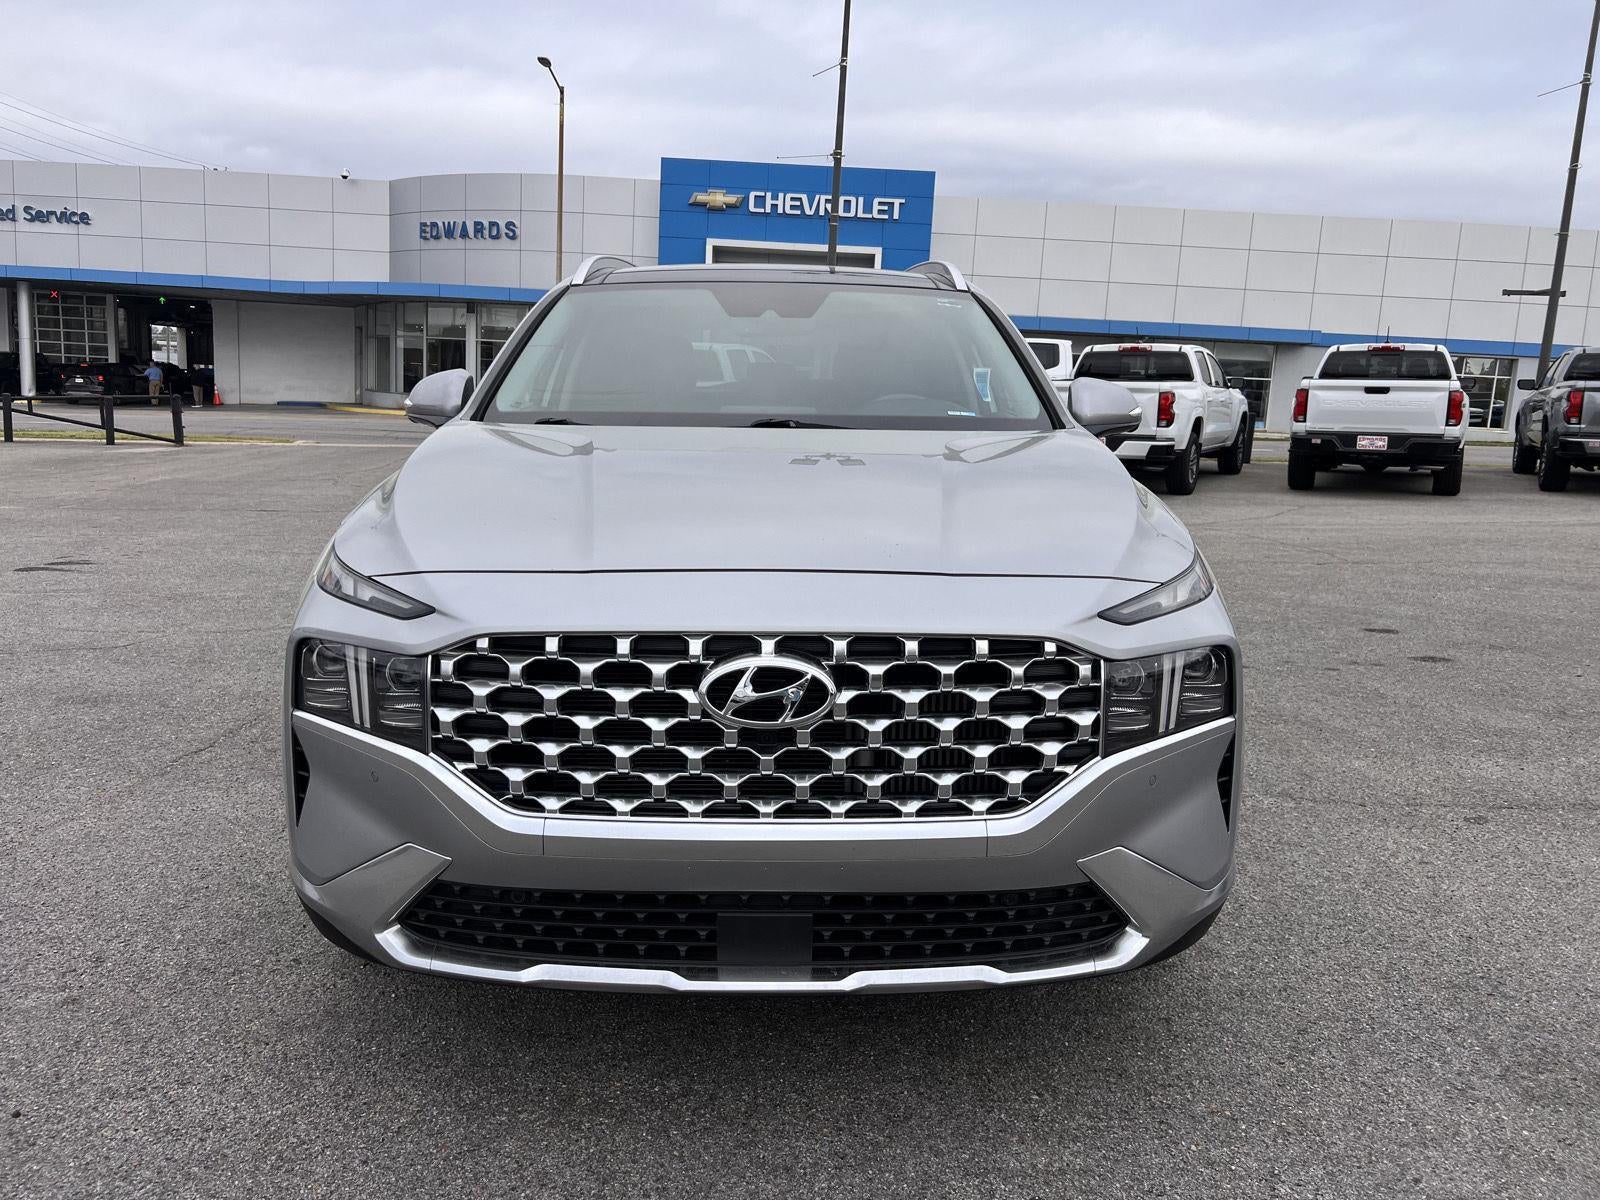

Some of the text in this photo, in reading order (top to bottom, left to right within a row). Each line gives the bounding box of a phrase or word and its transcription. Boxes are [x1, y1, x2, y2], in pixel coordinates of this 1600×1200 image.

[23, 205, 92, 225] Service
[748, 191, 906, 220] CHEVROLET
[419, 220, 519, 241] EDWARDS
